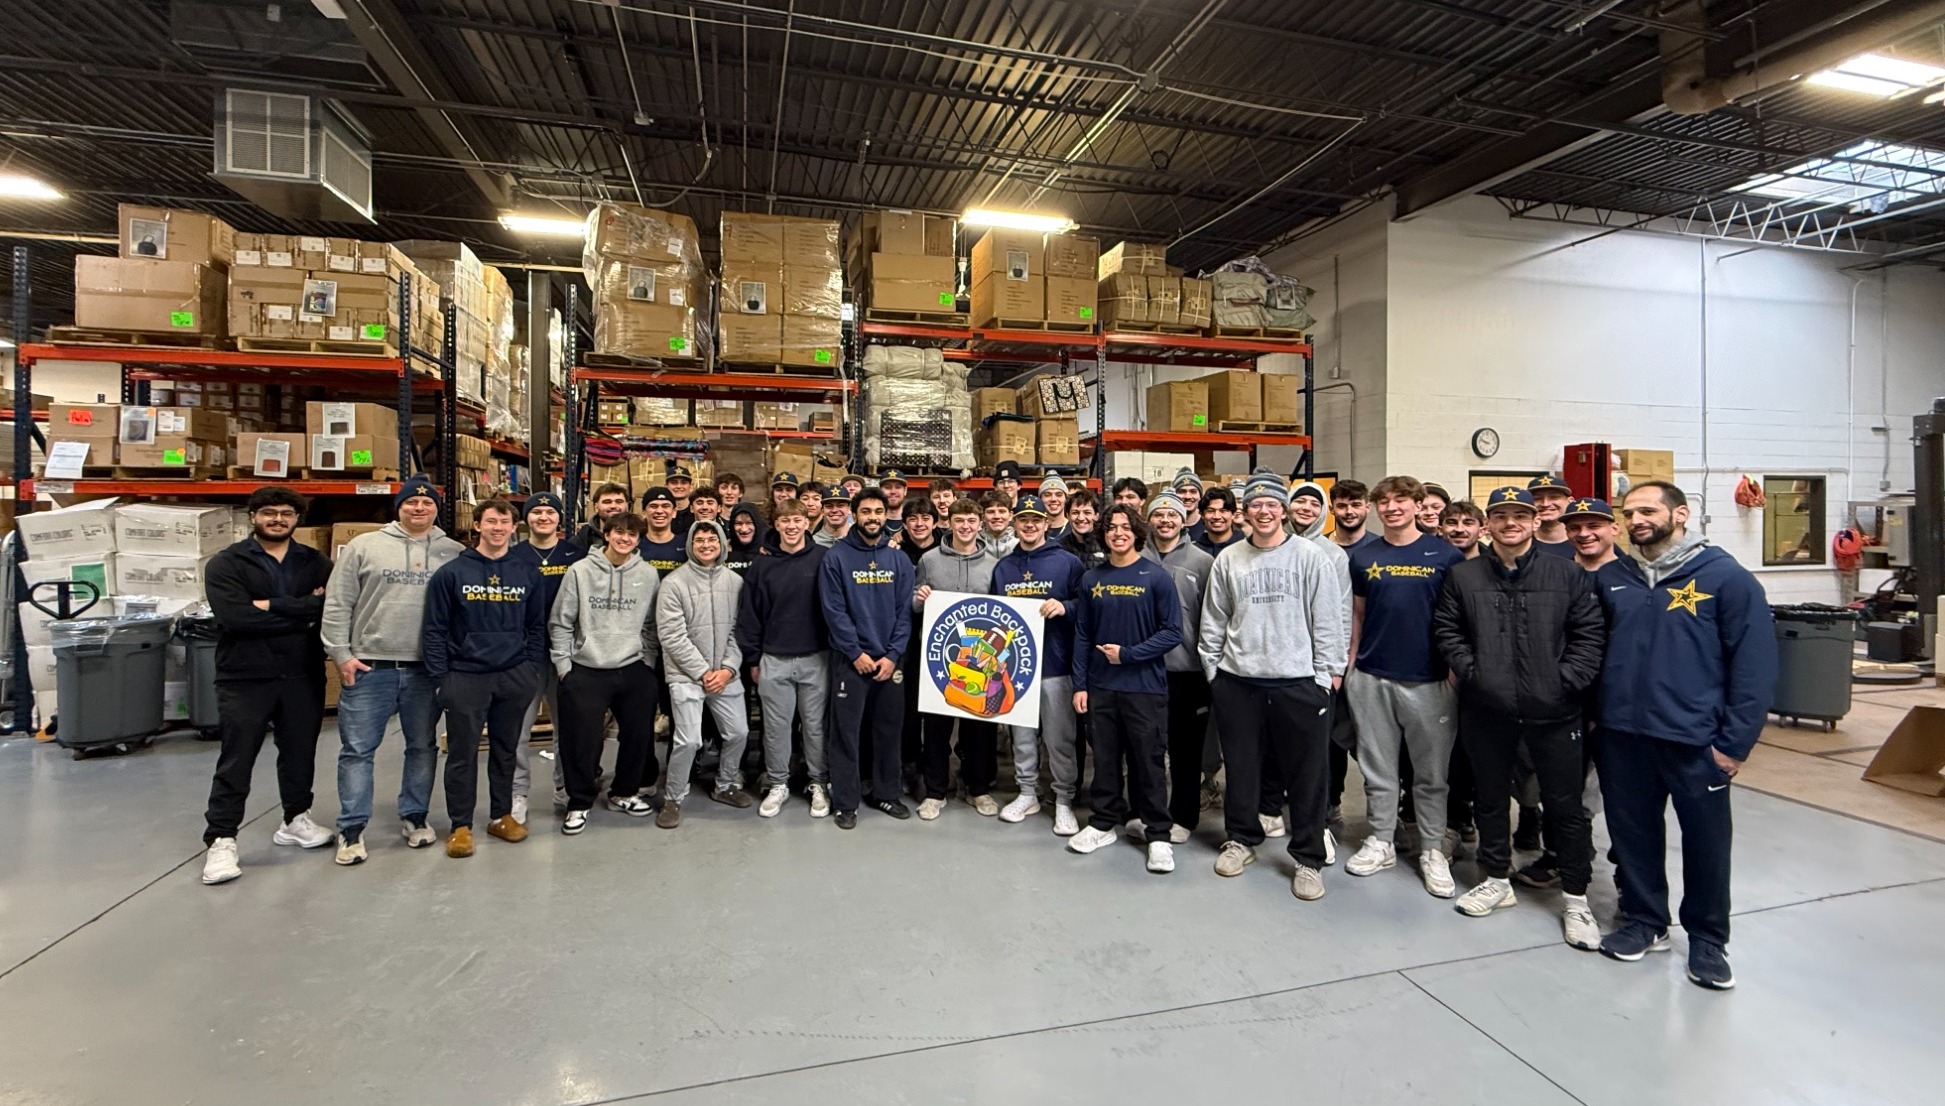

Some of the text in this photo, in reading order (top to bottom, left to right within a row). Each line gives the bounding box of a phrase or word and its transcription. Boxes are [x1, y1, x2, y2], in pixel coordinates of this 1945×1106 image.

[382, 569, 433, 579] DOMINIC
[852, 570, 895, 578] DOMINICAN
[1385, 565, 1436, 574] DOMINICAN
[1390, 570, 1429, 578] BASEBALL
[462, 585, 526, 595] DOMINICAN
[1004, 580, 1053, 592] DOMINICAN
[1106, 584, 1146, 593] DOMINICAN
[1007, 588, 1048, 597] BASEBALL
[467, 593, 522, 602] BASEBALL
[588, 596, 637, 605] DOMINICAN
[591, 603, 632, 611] BASEBALL
[928, 602, 1033, 676] Enchanted Backpack
